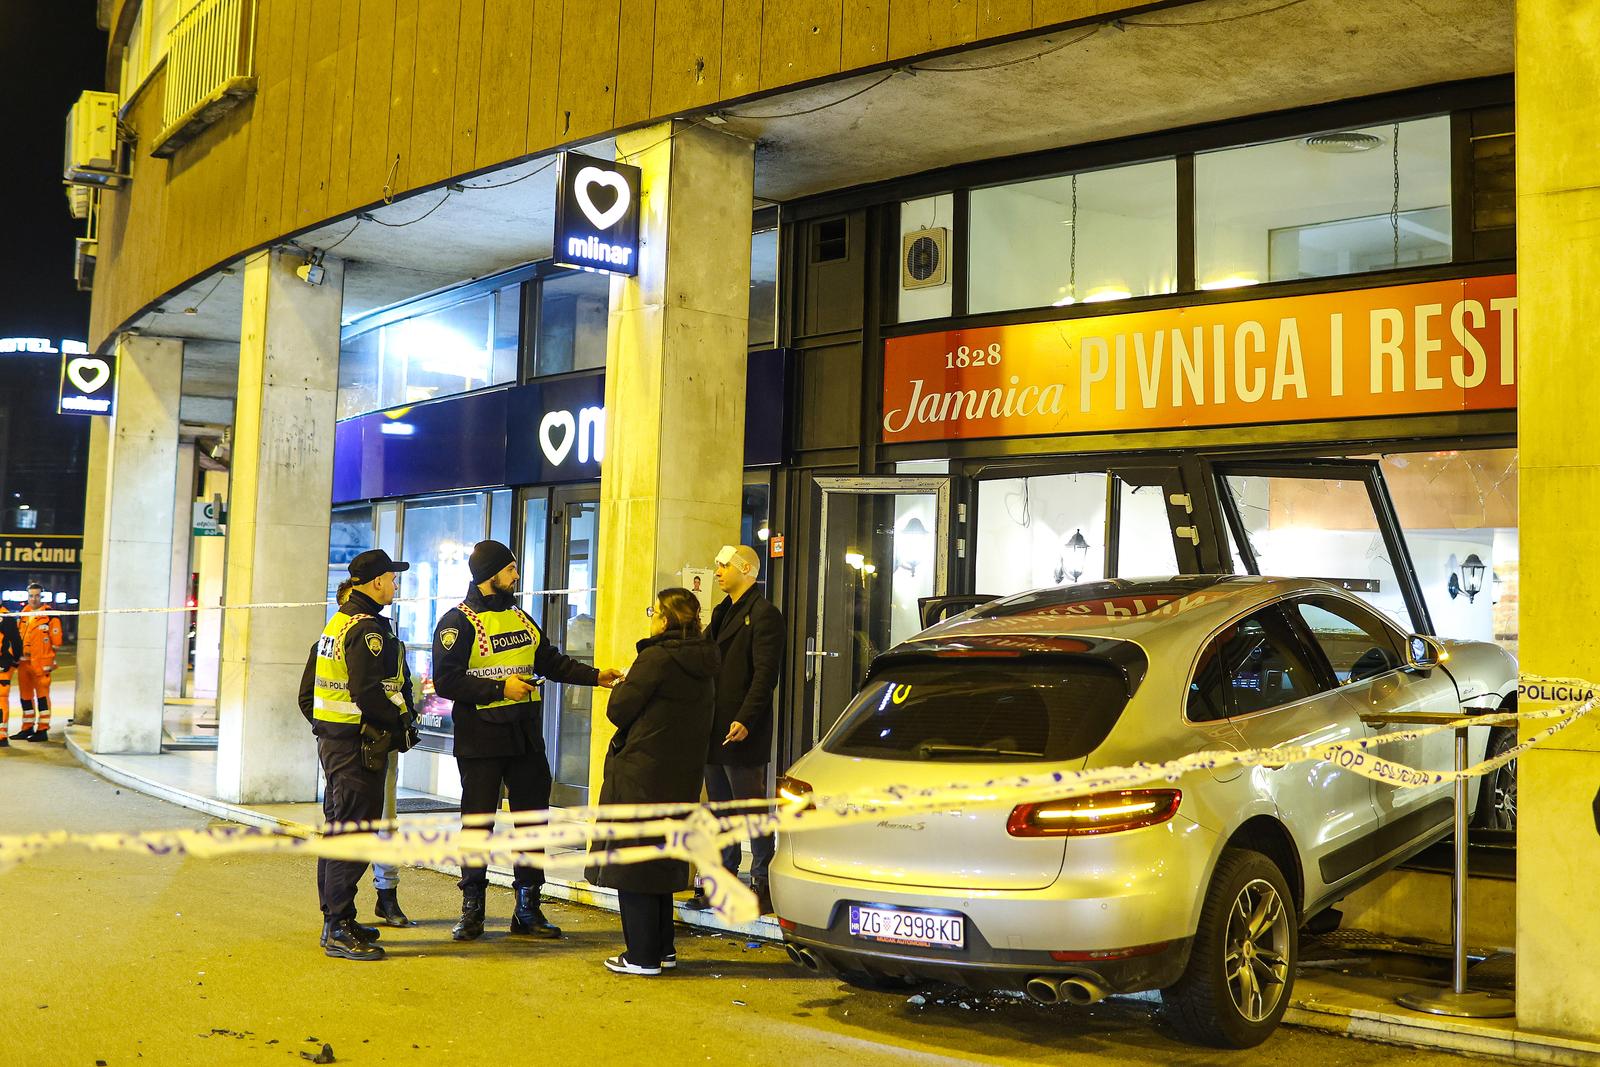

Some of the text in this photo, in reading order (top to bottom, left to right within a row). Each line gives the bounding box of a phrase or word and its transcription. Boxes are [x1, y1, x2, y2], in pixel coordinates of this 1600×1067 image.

[568, 236, 632, 266] mlinar
[945, 343, 1002, 369] 1828
[1080, 297, 1518, 413] PIVNICA I REST
[883, 375, 1066, 434] Jamnica
[14, 541, 77, 564] računu
[1518, 685, 1594, 702] POLICIJA
[861, 911, 881, 934] ZG
